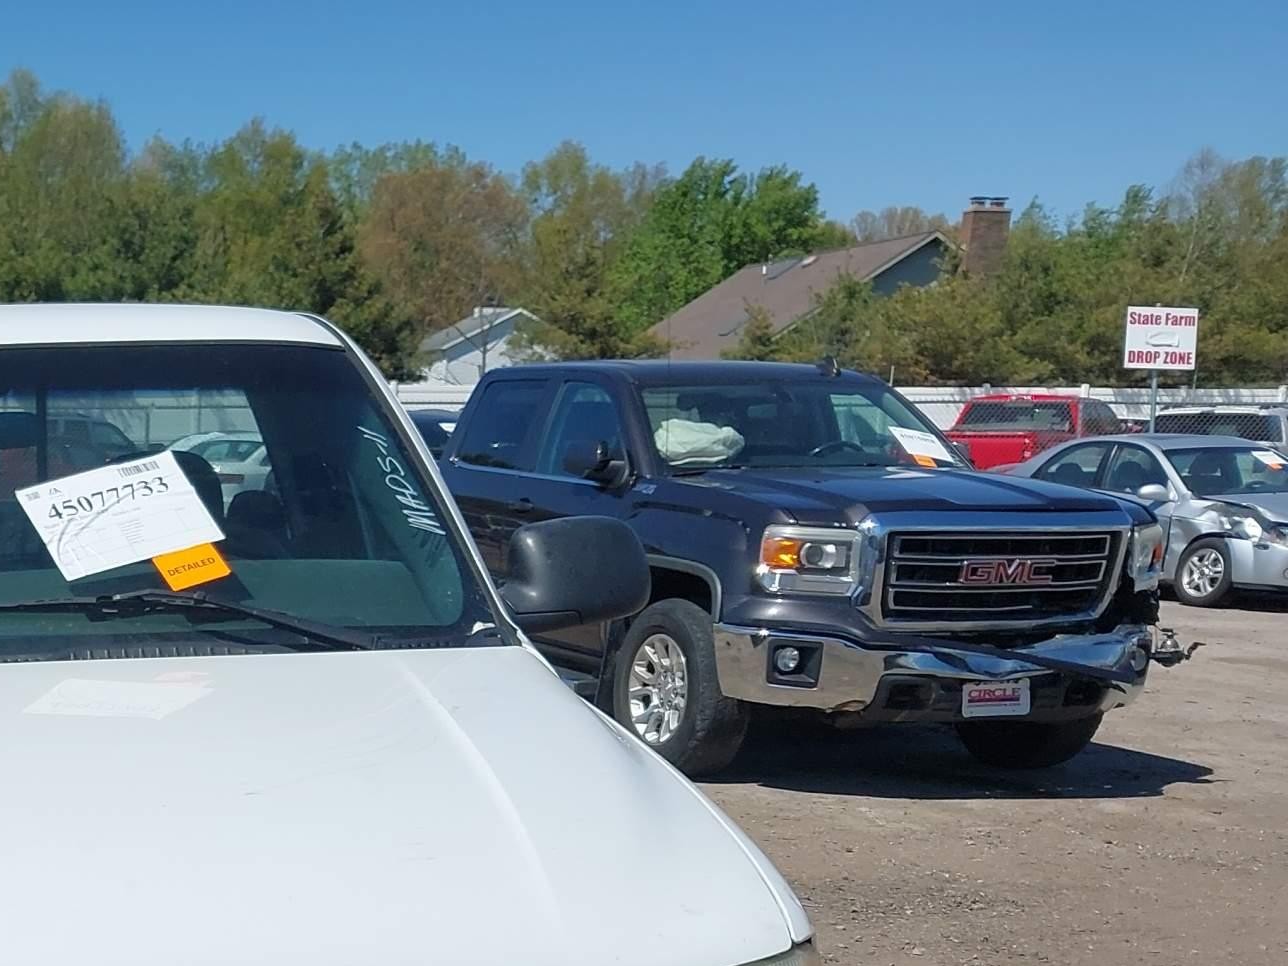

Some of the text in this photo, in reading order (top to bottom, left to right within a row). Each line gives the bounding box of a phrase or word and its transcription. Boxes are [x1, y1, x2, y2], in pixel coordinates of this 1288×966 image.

[1129, 311, 1196, 327] State Farm
[1128, 350, 1193, 365] DROP ZONE
[47, 476, 169, 520] 45077733
[167, 557, 216, 577] DETAILED
[961, 558, 1057, 585] GMC
[968, 688, 1021, 699] CIRCLE
